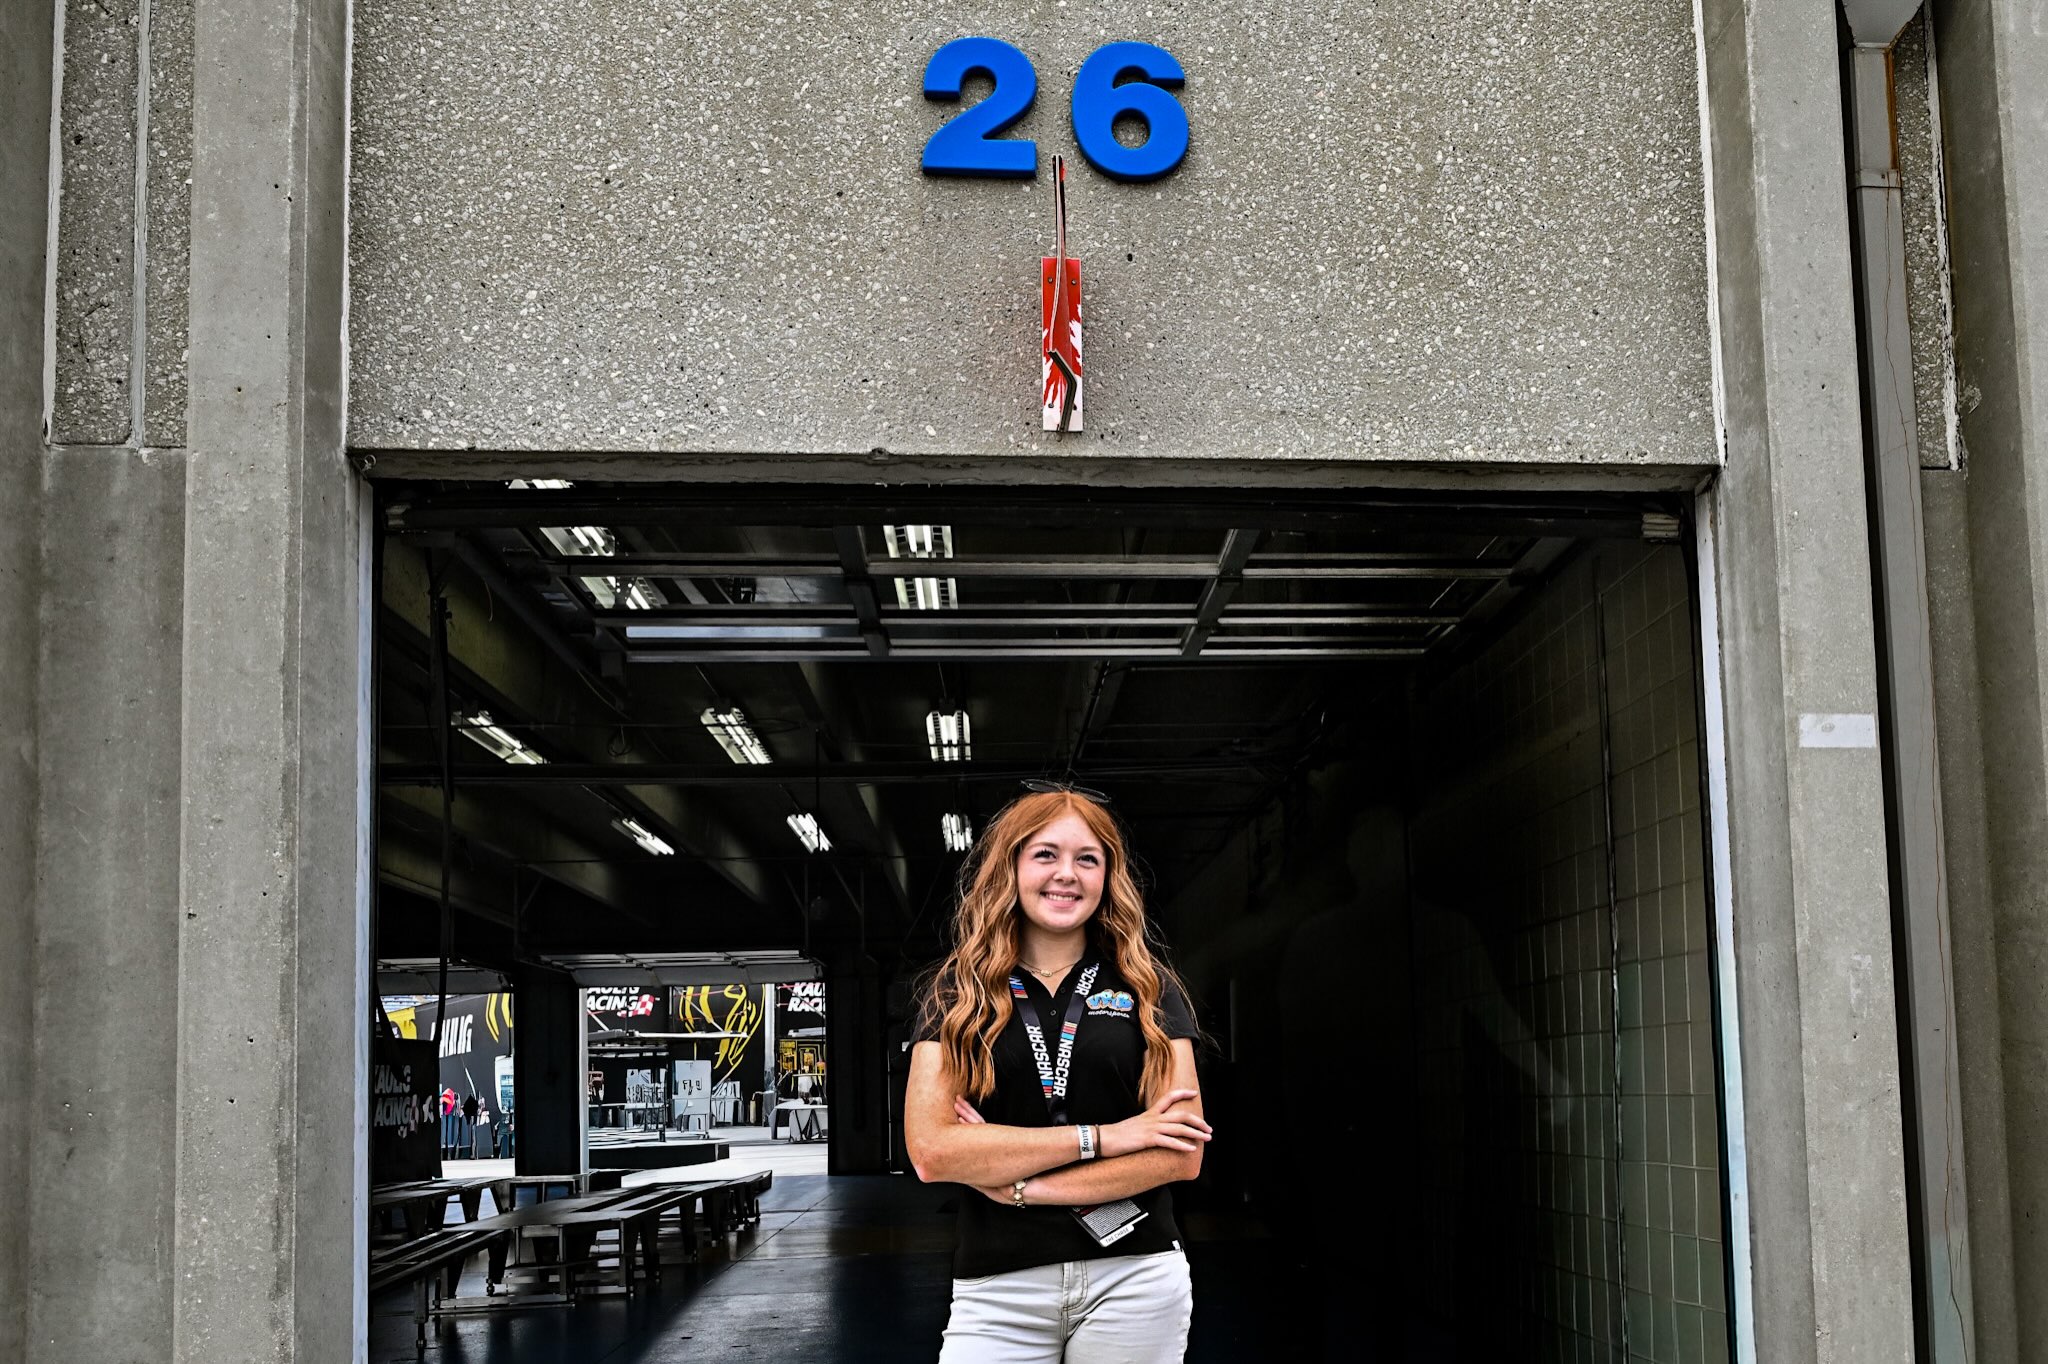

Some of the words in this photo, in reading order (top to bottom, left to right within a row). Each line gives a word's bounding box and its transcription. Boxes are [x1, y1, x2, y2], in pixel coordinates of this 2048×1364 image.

[921, 36, 1190, 182] 26
[587, 995, 639, 1011] ACING
[792, 982, 826, 997] KAU
[1075, 963, 1100, 998] SCAR
[1027, 1024, 1055, 1081] NASCAR
[1053, 1038, 1074, 1097] NASCAR
